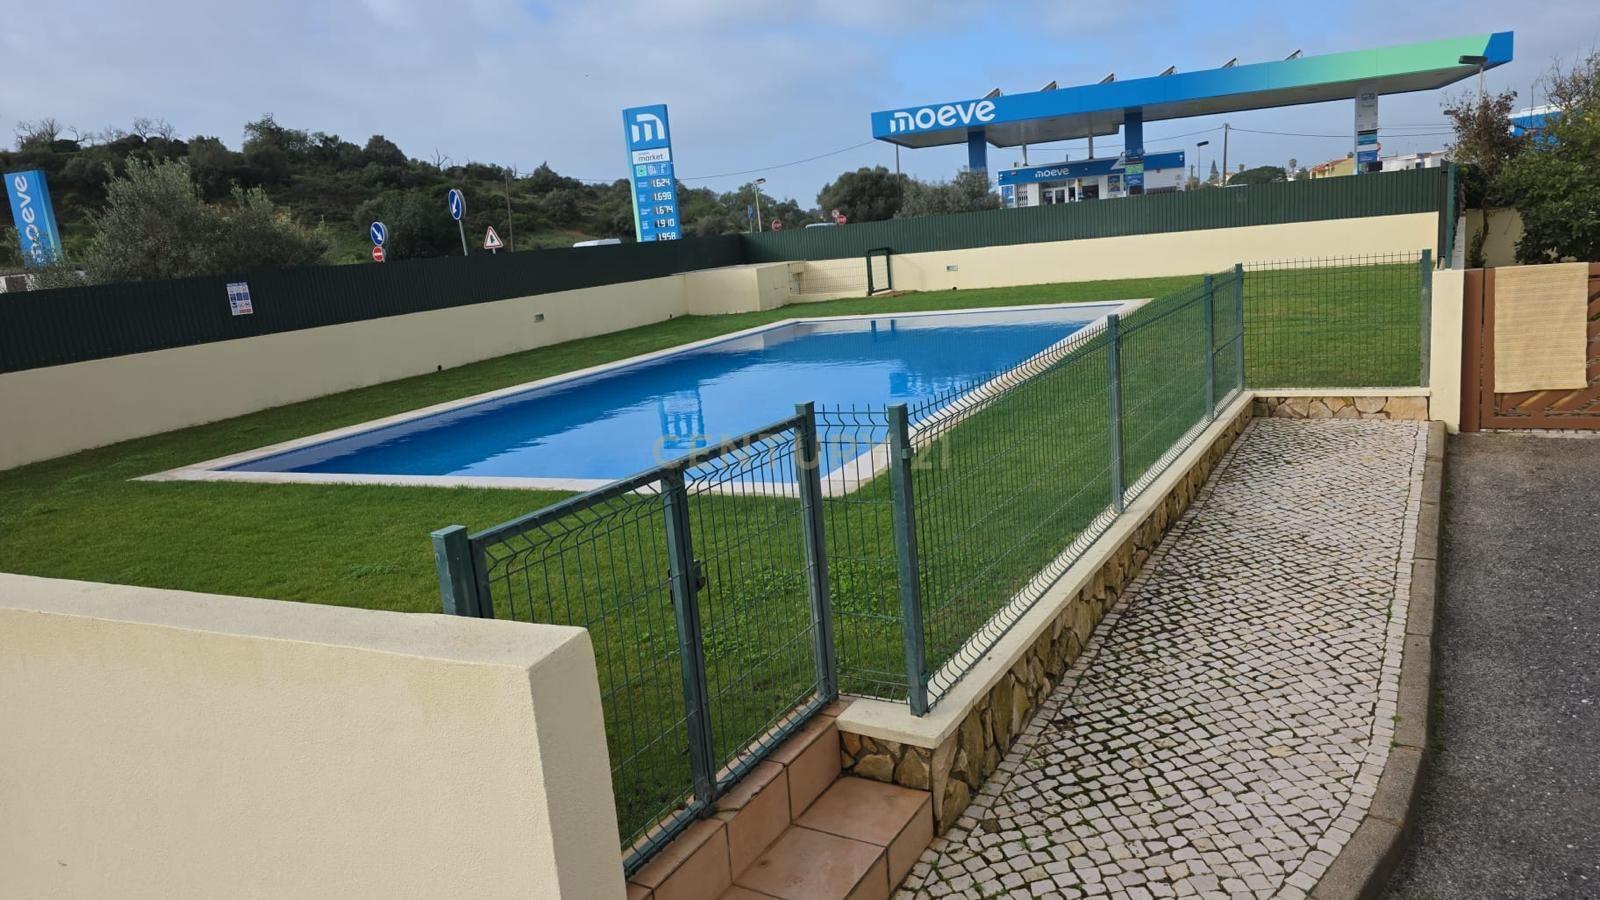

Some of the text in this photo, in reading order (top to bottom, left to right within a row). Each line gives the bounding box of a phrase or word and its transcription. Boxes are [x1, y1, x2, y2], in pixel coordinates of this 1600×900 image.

[889, 100, 996, 133] moeve
[638, 154, 664, 162] market
[1034, 167, 1070, 178] moeve
